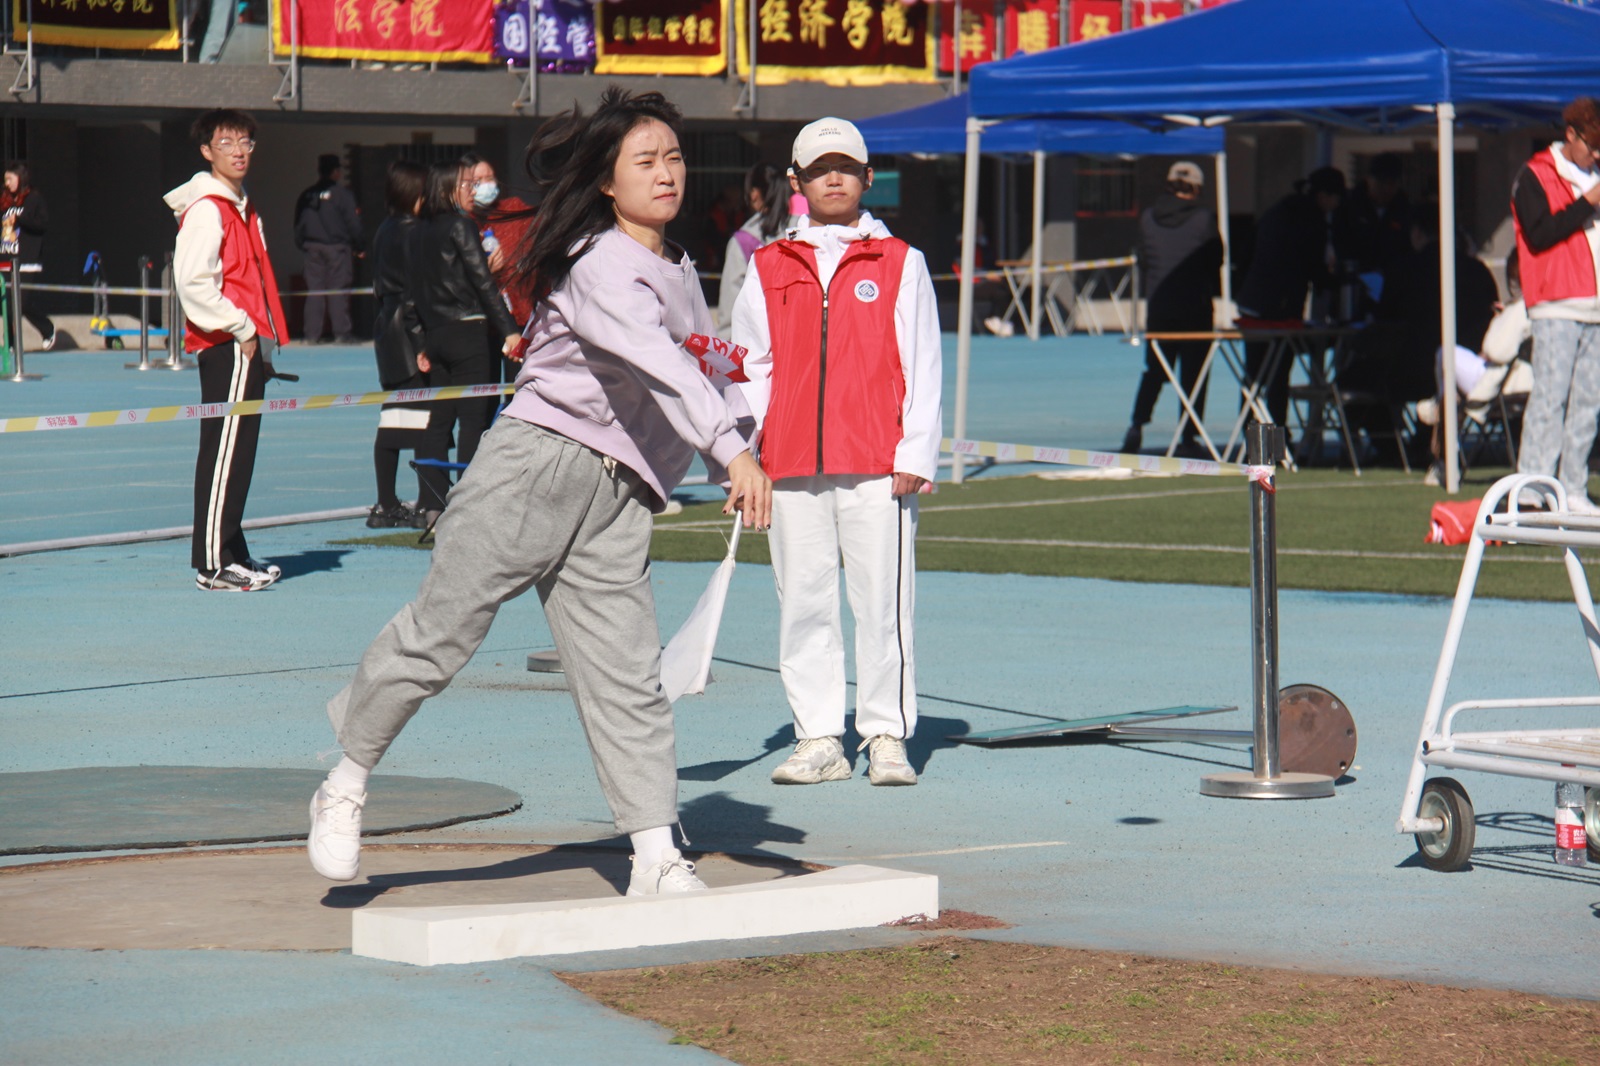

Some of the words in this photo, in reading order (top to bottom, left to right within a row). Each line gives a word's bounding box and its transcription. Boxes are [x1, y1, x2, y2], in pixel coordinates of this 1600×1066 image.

[334, 0, 444, 39] 法学院
[759, 0, 914, 49] 经济学院
[396, 388, 432, 401] LIMITLINE
[186, 404, 224, 418] LIMITLINE
[269, 399, 297, 411] 警戒线
[45, 415, 78, 428] 警戒线
